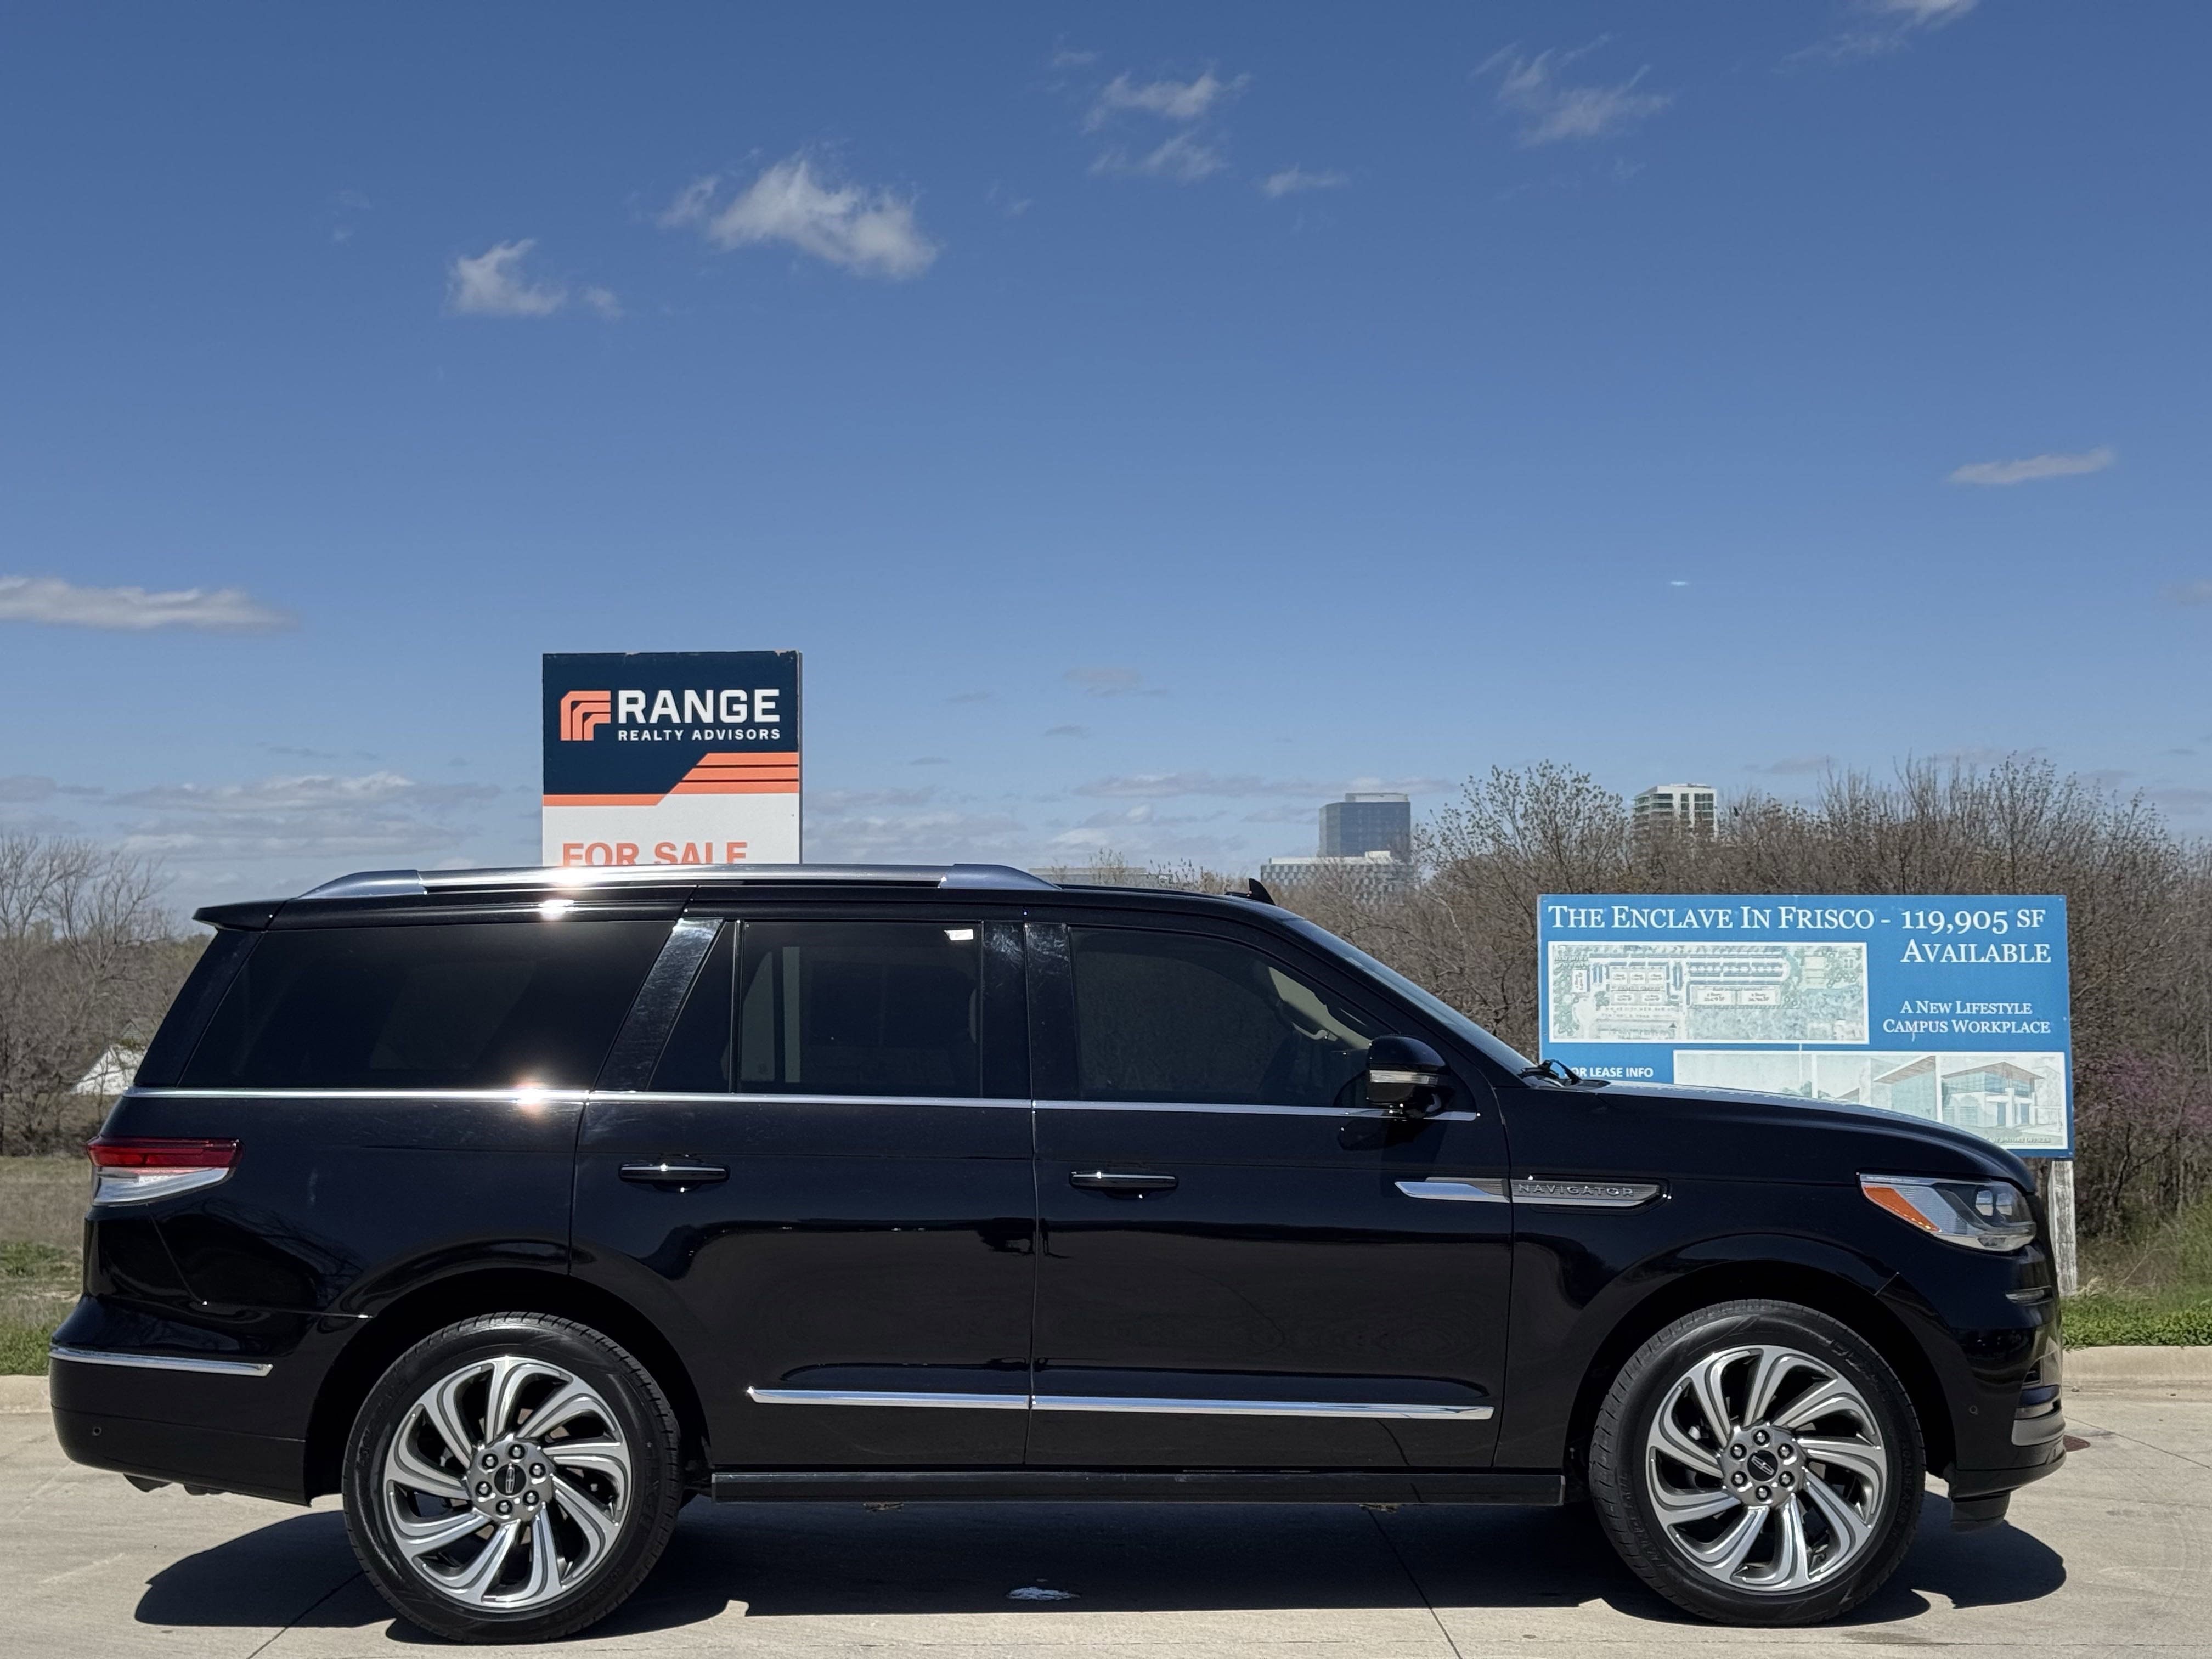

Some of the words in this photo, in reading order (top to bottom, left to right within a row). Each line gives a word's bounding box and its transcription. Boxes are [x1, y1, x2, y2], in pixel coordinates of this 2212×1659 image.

[618, 689, 780, 724] RANGE
[618, 730, 682, 741] REALTY
[691, 729, 781, 740] ADVISORS
[562, 842, 639, 865] FOR
[1548, 906, 1605, 928] THE
[1611, 906, 1734, 928] ENCLAVE
[1740, 906, 1772, 928] IN
[1778, 906, 1875, 929] FRISCO
[1901, 910, 2009, 934] 119,905
[2016, 909, 2046, 928] SF
[1900, 939, 2051, 963] AVAILABLE
[1900, 1000, 1912, 1014] A
[1916, 1000, 1952, 1014] NEW
[1955, 1000, 2033, 1014] LIFESTYLE
[1883, 1019, 1949, 1034] CAMPUS
[1951, 1019, 2051, 1034] WORKPLACE
[1565, 1067, 1588, 1078] OR
[1589, 1067, 1623, 1078] LEASE
[1626, 1067, 1654, 1079] INFO
[1518, 1183, 1634, 1197] NAVIGATOR
